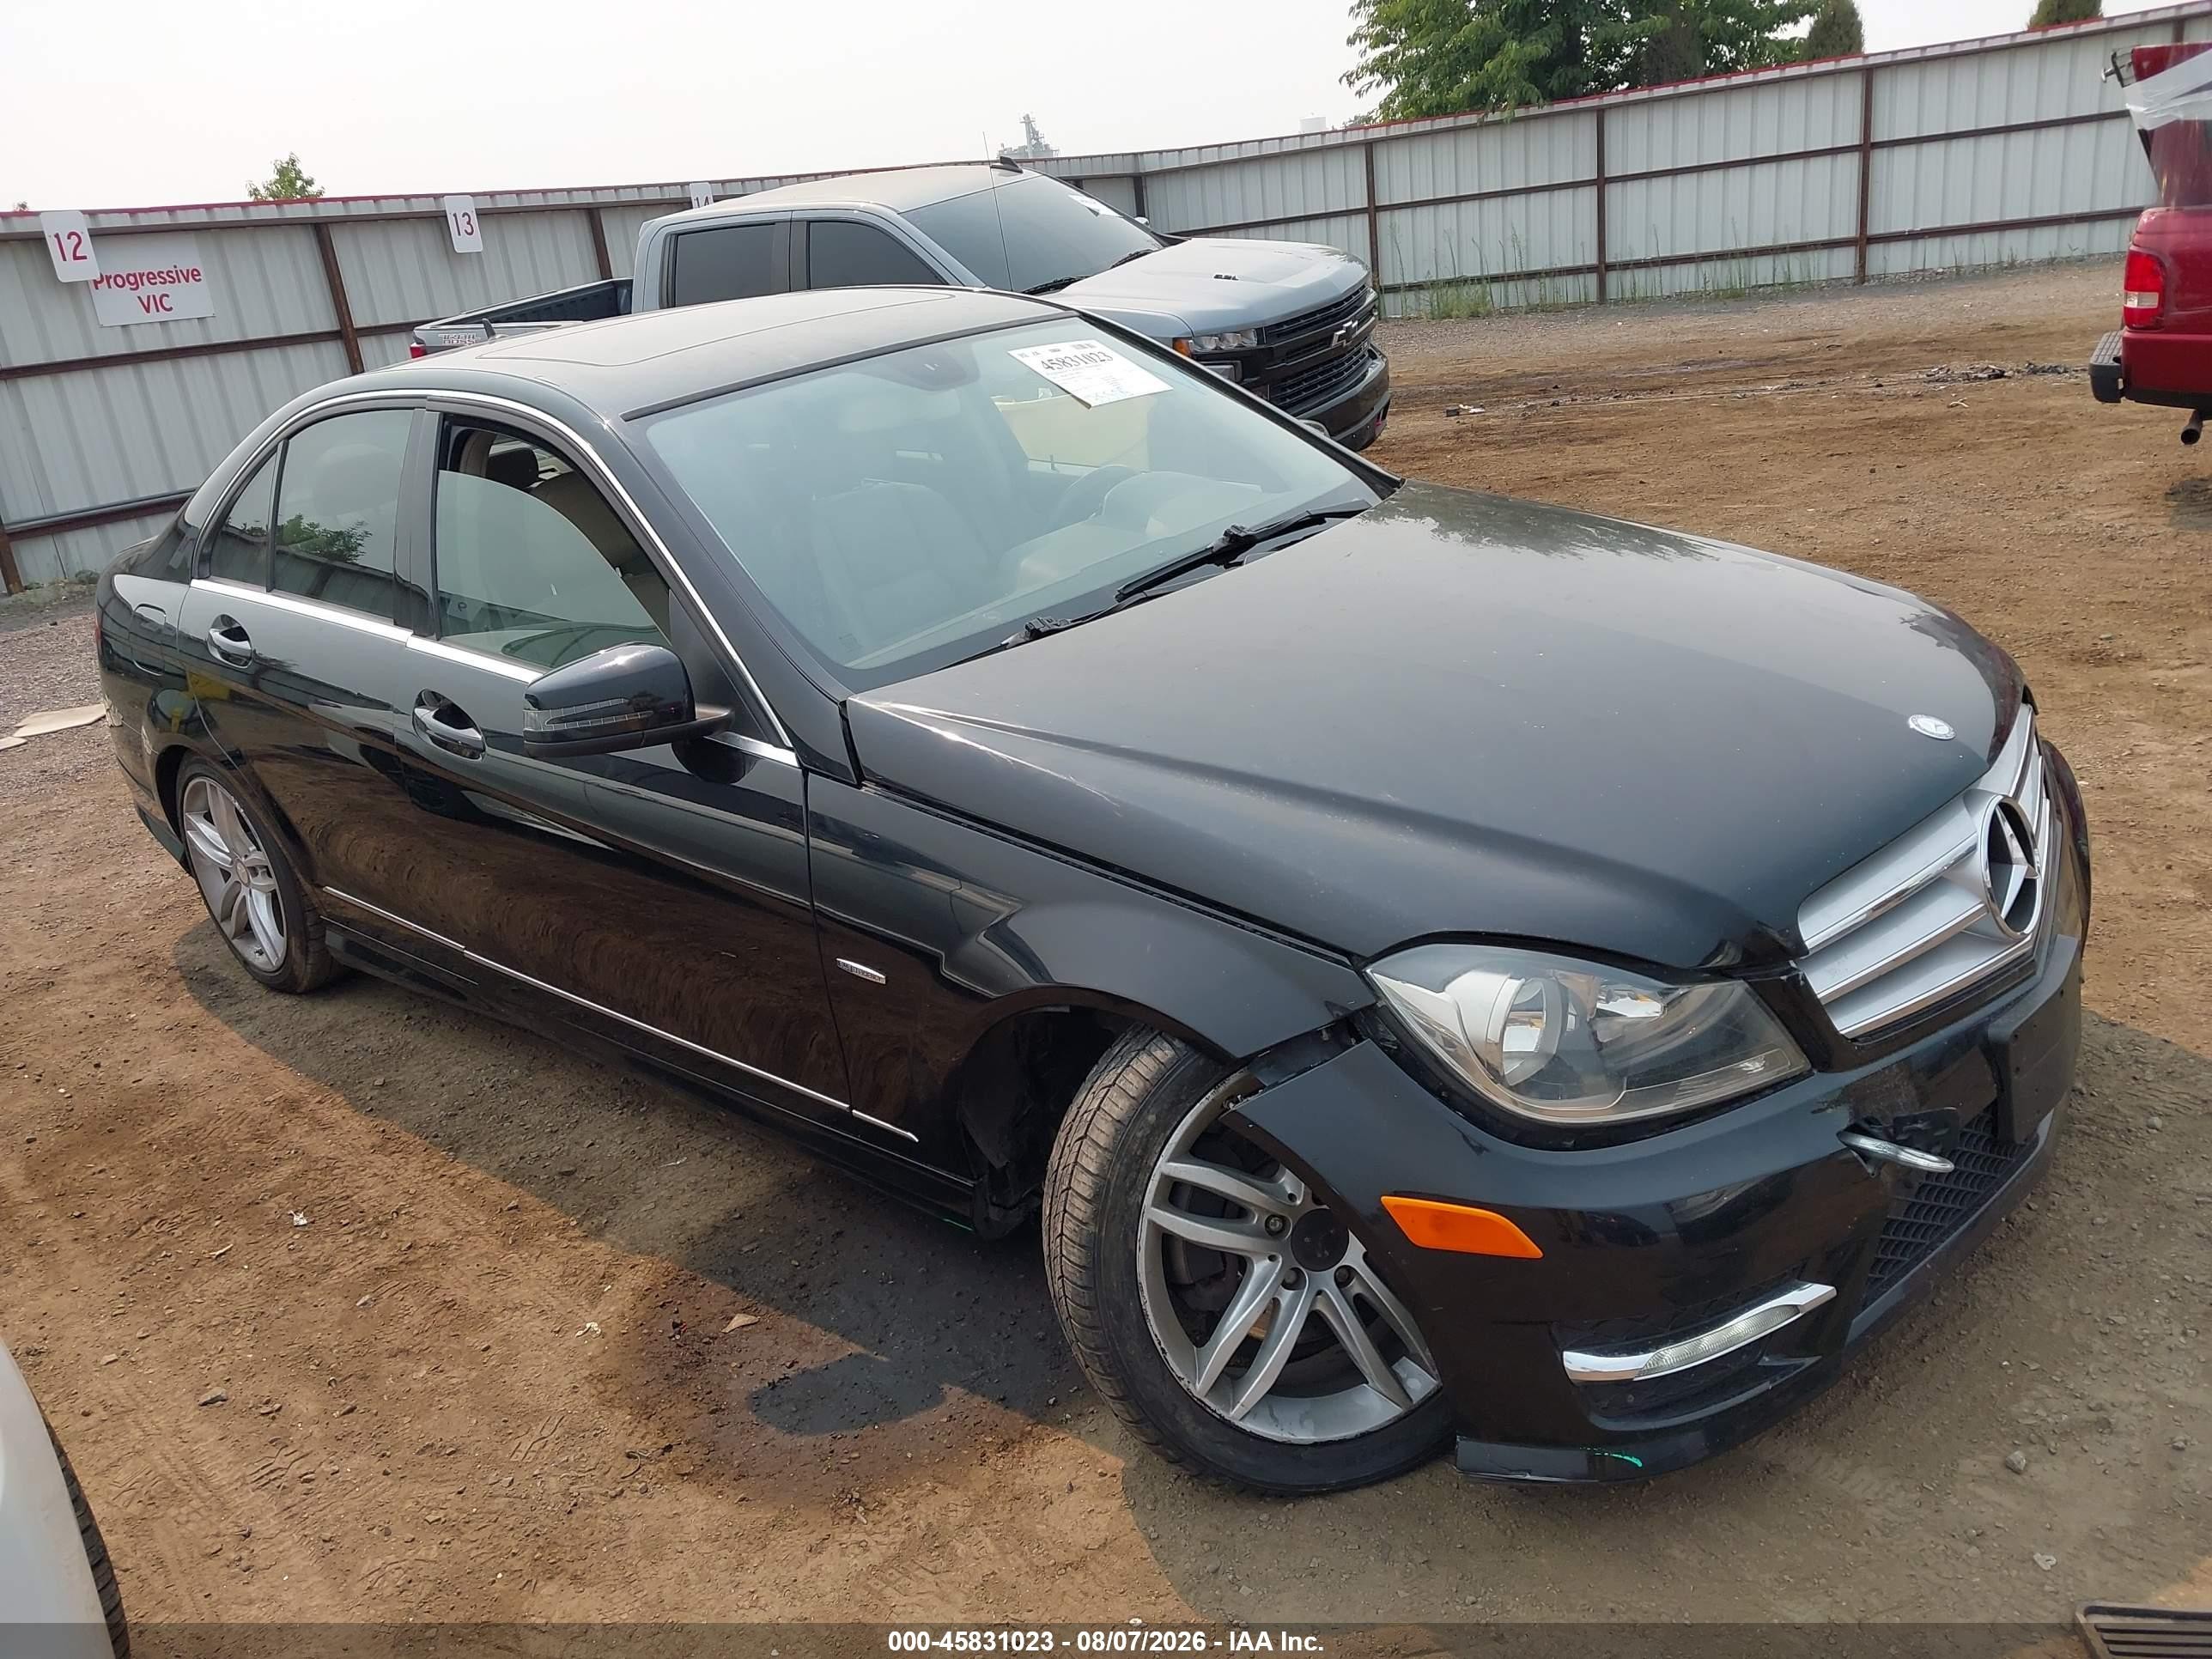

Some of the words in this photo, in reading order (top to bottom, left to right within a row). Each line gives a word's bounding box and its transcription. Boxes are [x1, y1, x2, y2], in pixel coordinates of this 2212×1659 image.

[453, 211, 475, 236] 13
[53, 230, 88, 262] 12
[93, 264, 203, 291] Progressive
[137, 293, 174, 314] VIC
[1041, 351, 1114, 371] 45831023
